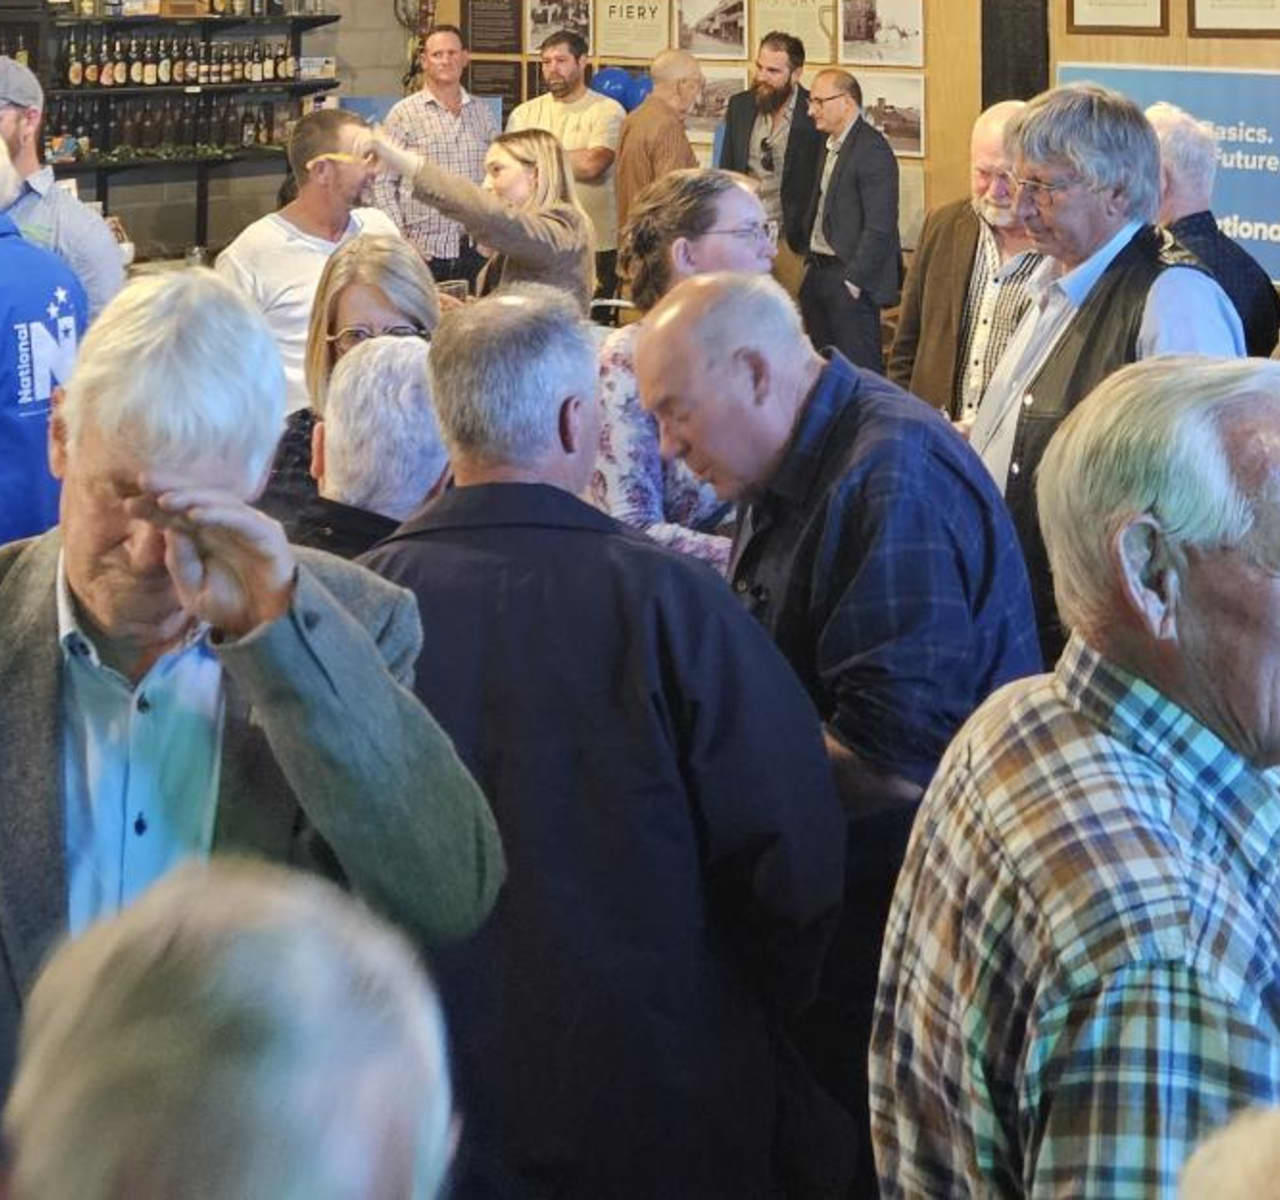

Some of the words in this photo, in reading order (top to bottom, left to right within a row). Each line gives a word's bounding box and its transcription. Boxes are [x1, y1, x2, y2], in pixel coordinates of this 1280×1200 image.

[608, 5, 660, 20] FIERY
[1214, 121, 1274, 144] asics.
[13, 322, 33, 404] National
